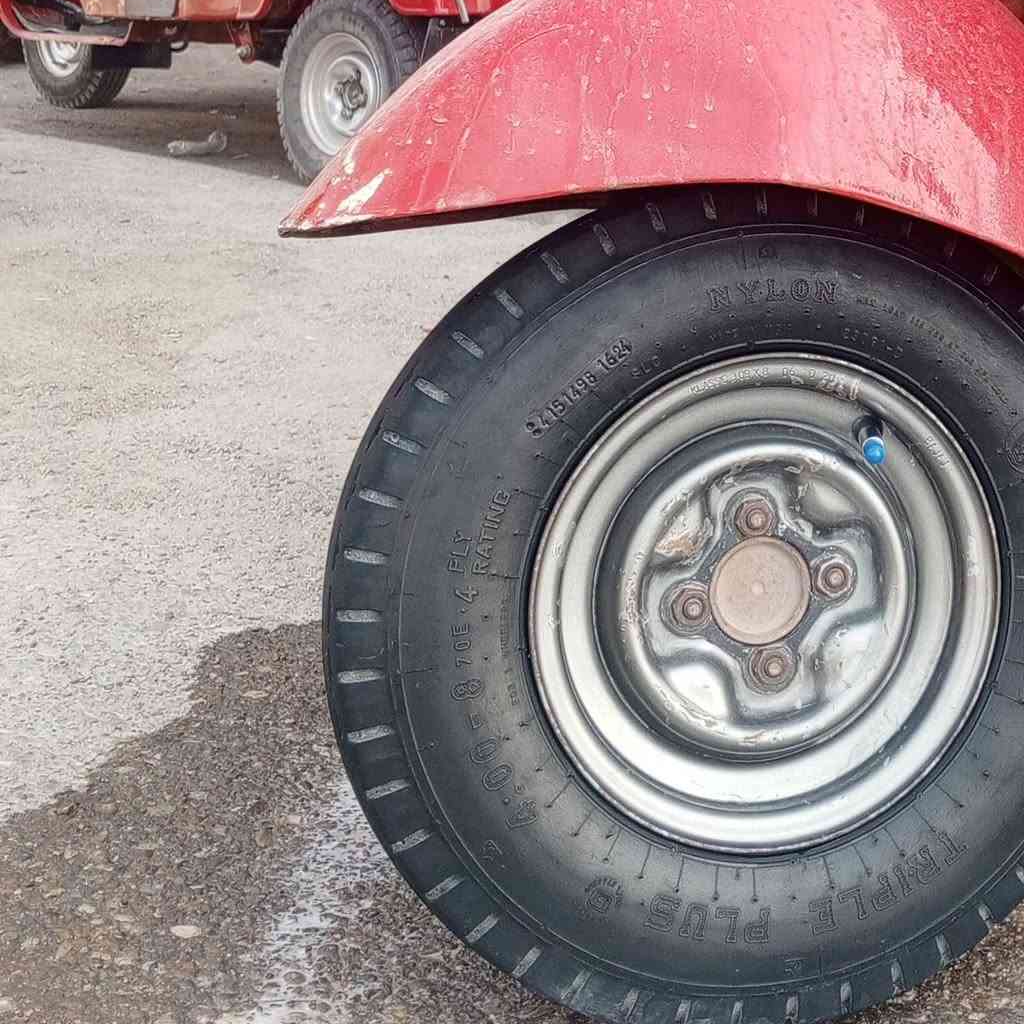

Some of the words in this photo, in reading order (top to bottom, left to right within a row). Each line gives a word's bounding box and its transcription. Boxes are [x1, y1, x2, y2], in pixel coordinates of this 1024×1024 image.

[706, 277, 840, 314] NYLON
[447, 529, 474, 574] PLY
[472, 488, 513, 576] RATING
[455, 584, 480, 604] 4
[808, 829, 970, 937] TRIPLE
[643, 893, 771, 944] PLUS
